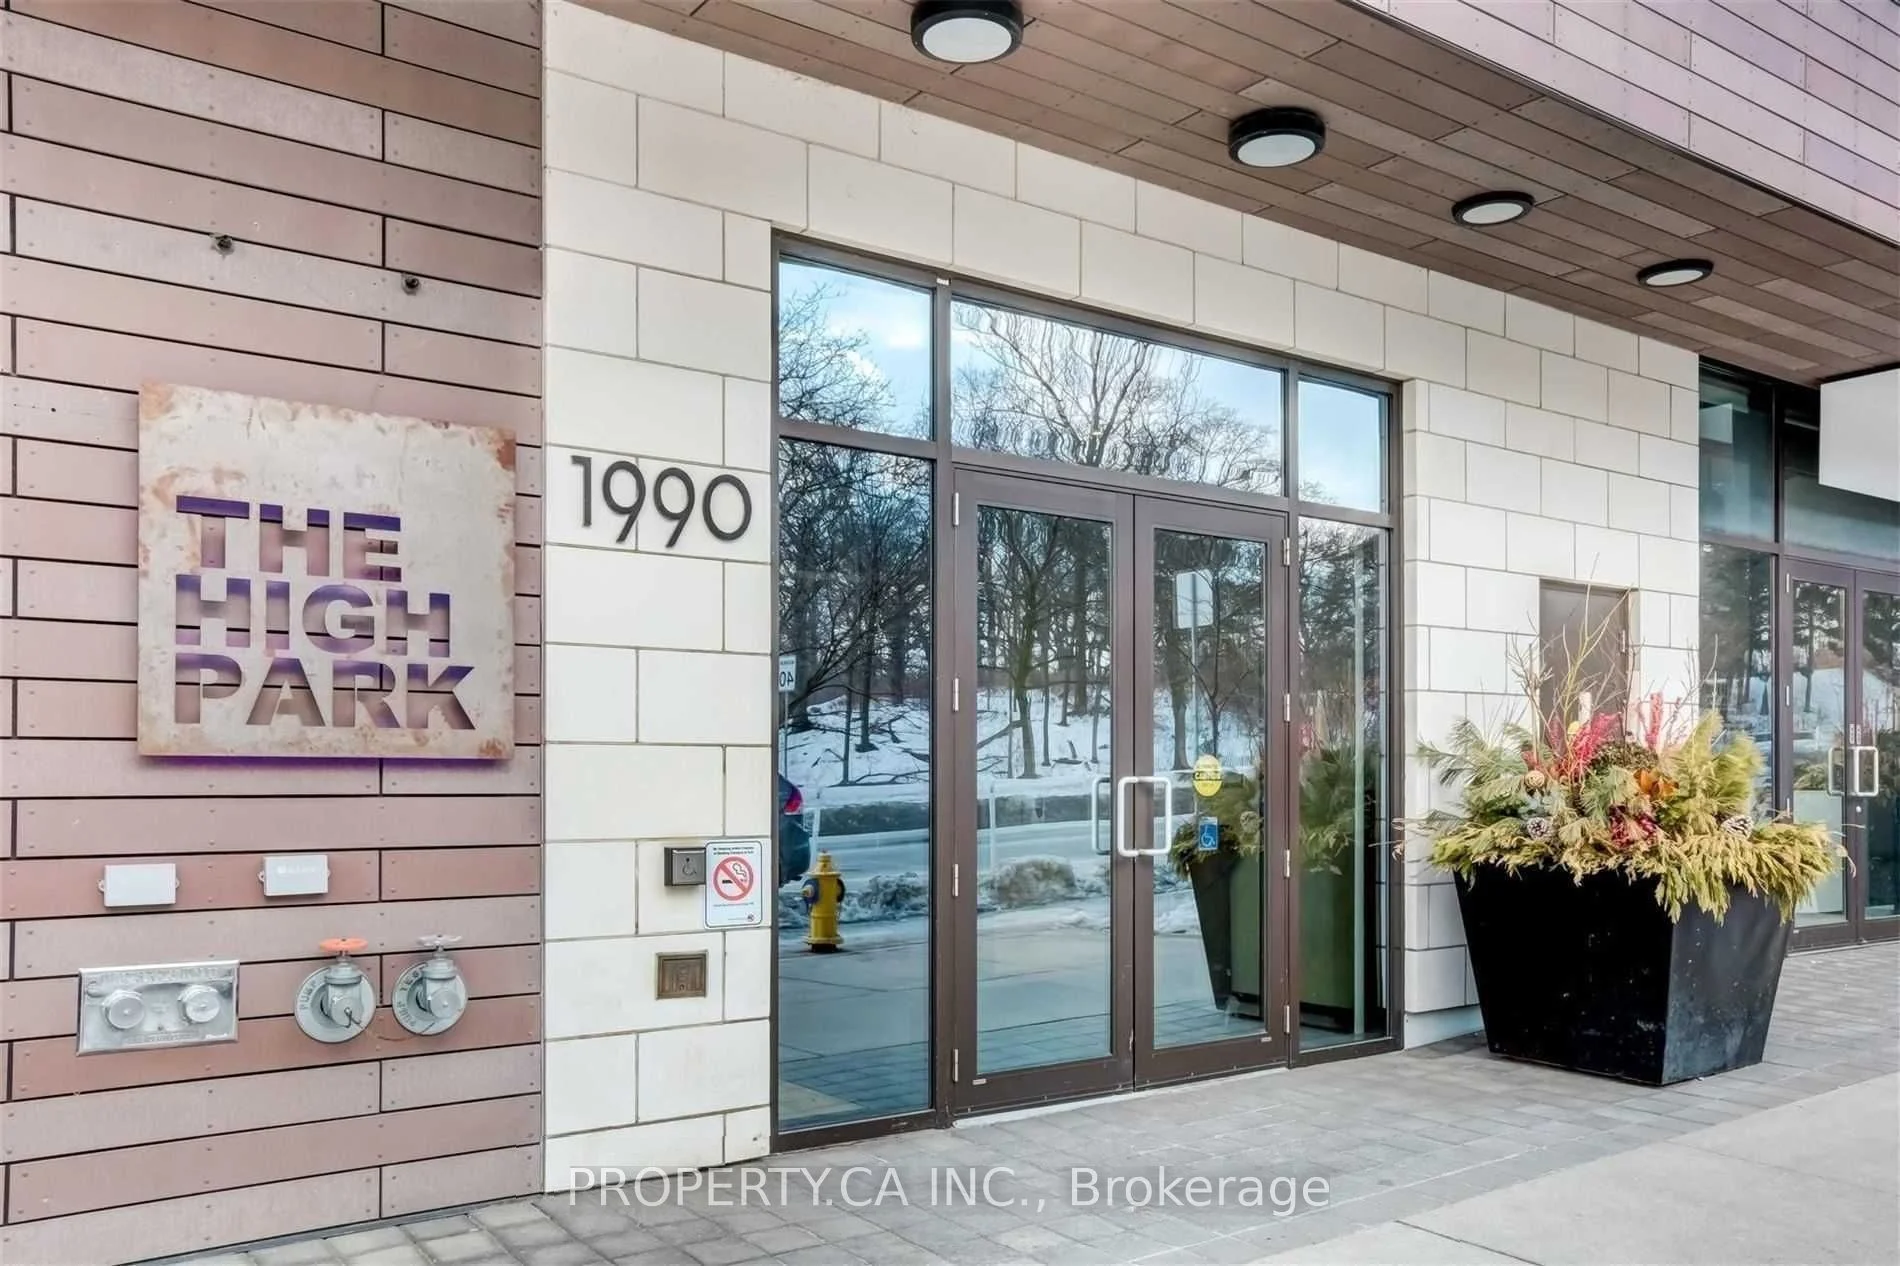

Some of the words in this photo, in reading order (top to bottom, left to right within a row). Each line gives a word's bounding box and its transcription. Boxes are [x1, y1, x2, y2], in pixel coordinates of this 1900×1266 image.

[176, 495, 402, 582] THE
[571, 455, 752, 548] 1990
[175, 574, 451, 658] HIGH
[174, 652, 476, 731] PARK
